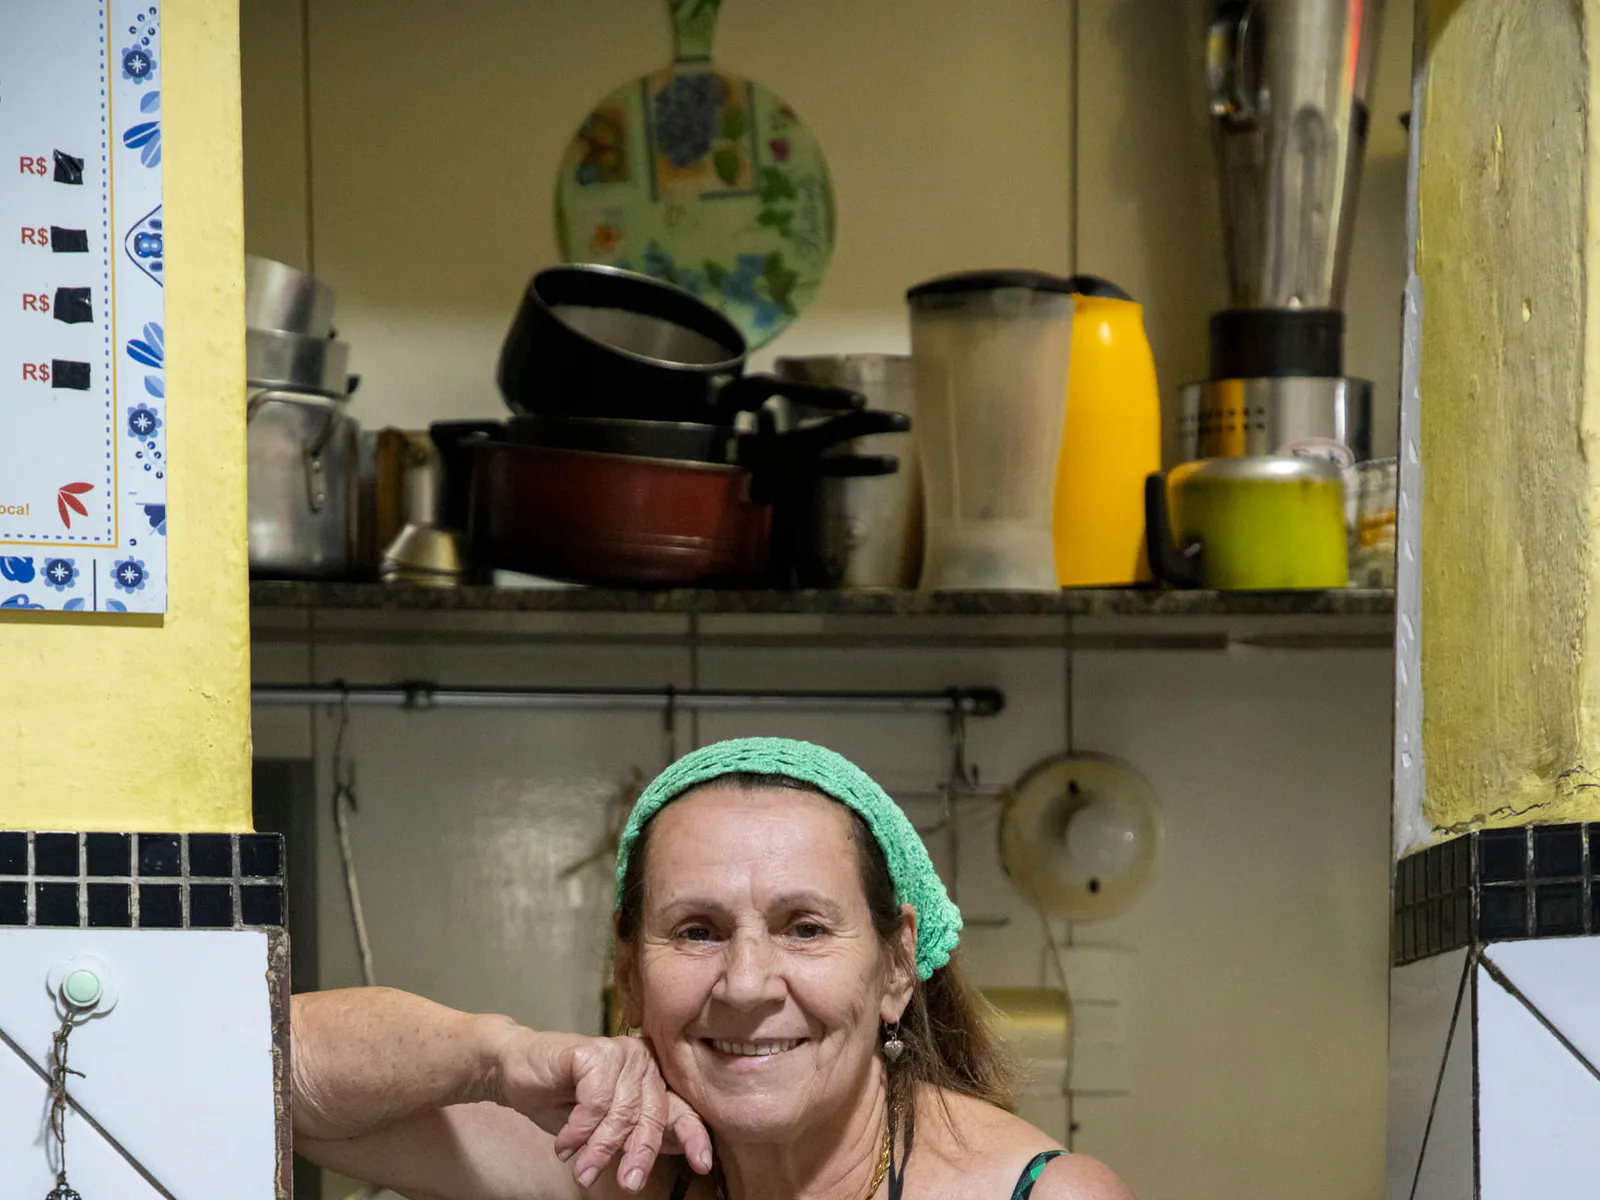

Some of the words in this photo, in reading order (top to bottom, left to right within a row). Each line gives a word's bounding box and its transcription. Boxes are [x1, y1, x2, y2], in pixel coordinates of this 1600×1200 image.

[20, 156, 47, 176] R$
[21, 227, 48, 247] R$
[23, 293, 50, 313] R$
[23, 363, 50, 383] R$
